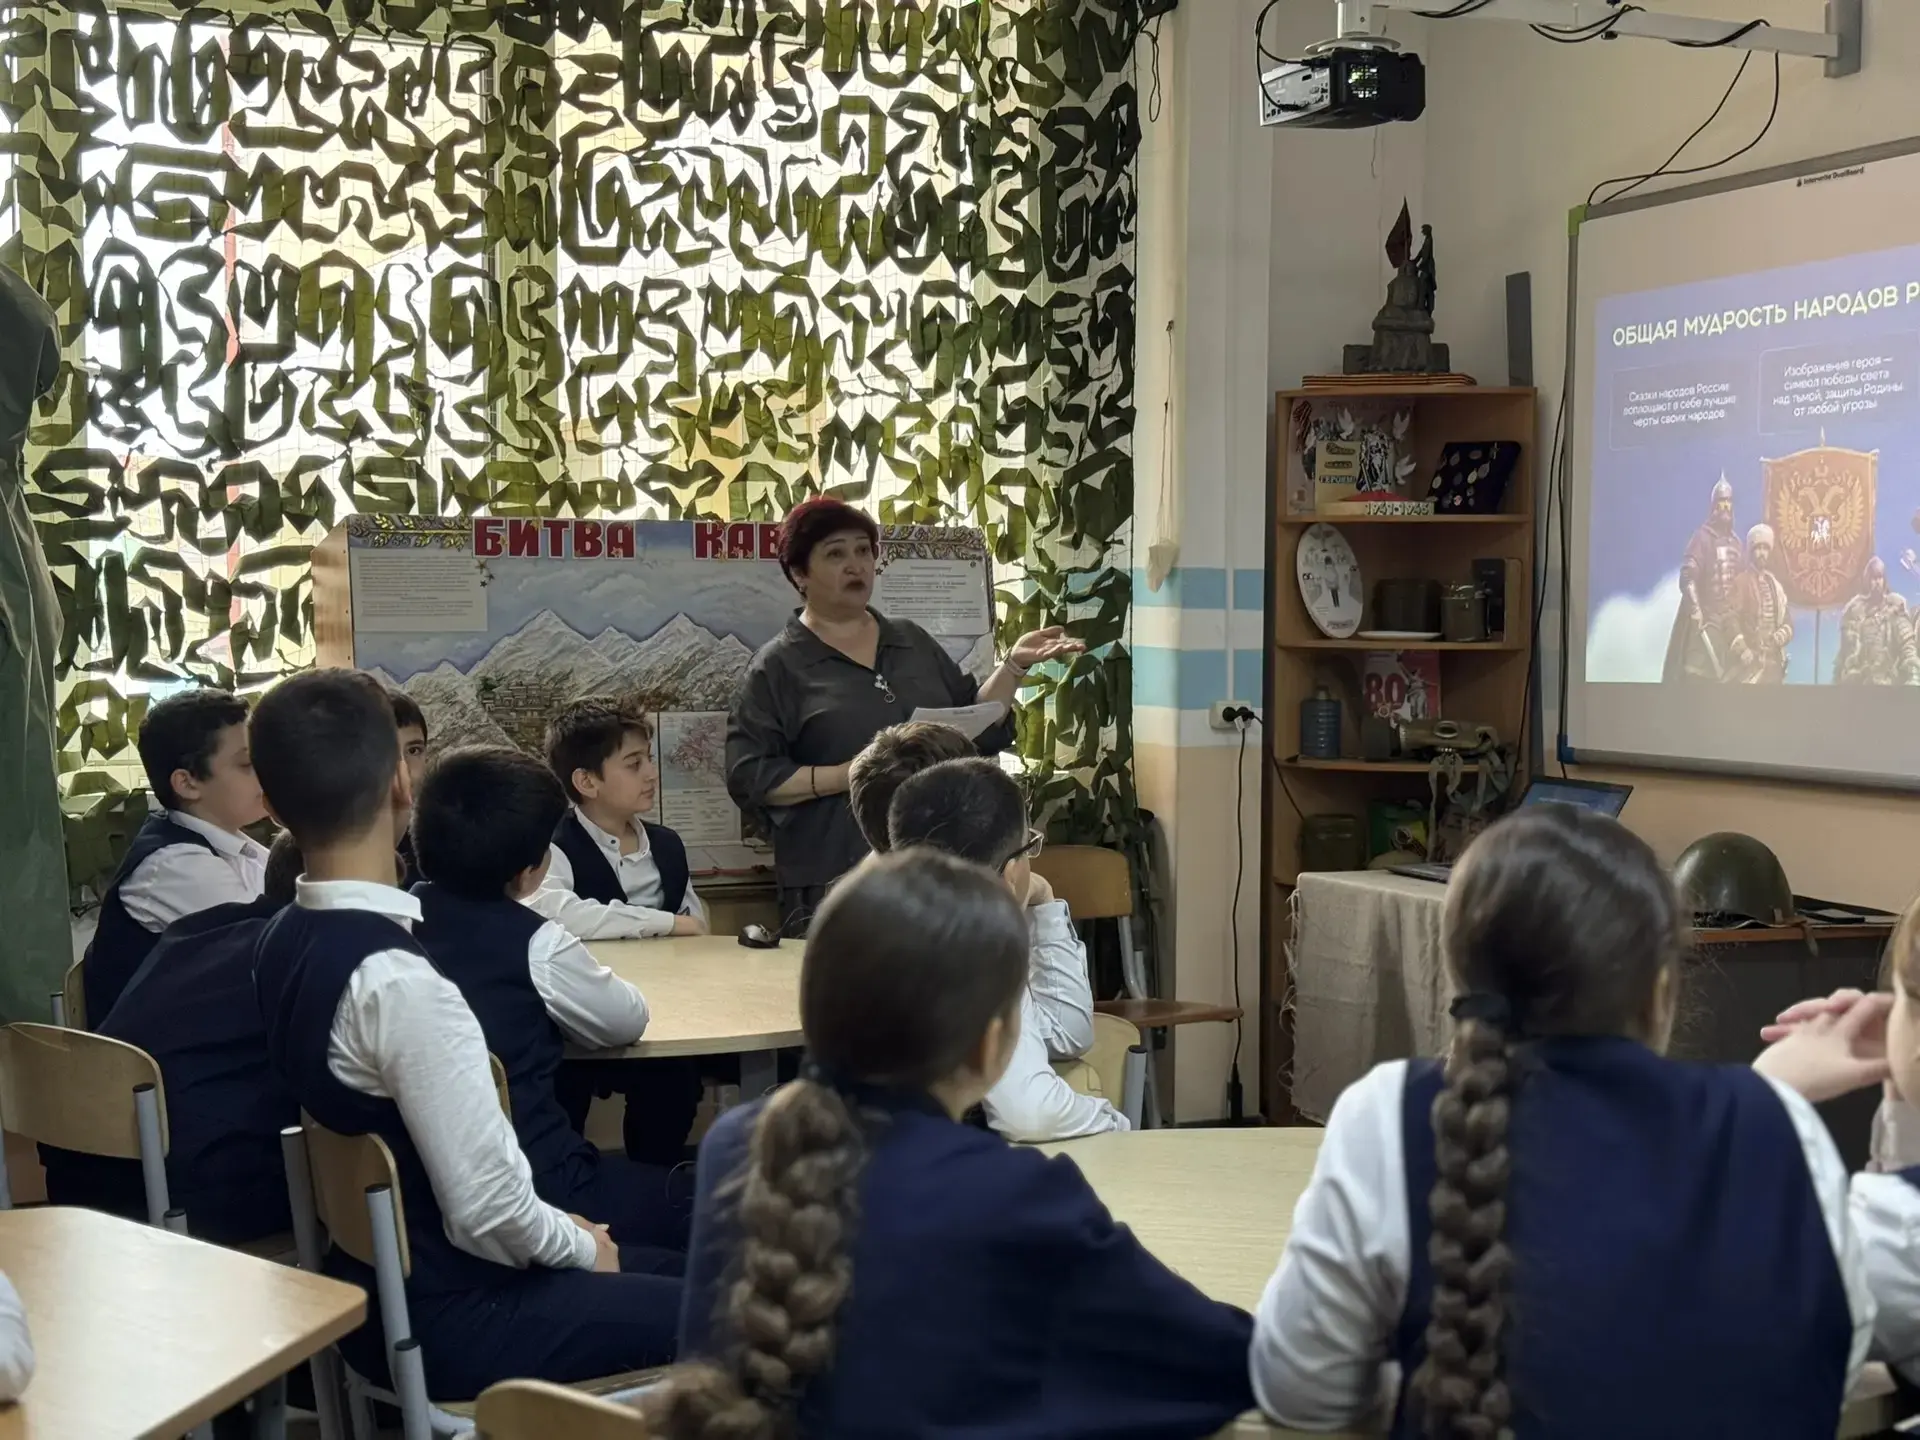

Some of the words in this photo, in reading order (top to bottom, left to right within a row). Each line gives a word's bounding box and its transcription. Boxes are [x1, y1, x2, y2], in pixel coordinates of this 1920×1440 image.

[1612, 319, 1677, 346] ОБЩАЯ
[1684, 304, 1787, 337] МУДРОСТЬ
[1794, 285, 1899, 321] НАРОДОВ
[1784, 362, 1850, 377] Изображение
[1851, 356, 1882, 370] героя
[1784, 377, 1820, 391] символ
[1820, 371, 1859, 386] победы
[1860, 370, 1890, 382] света
[1628, 391, 1658, 402] Сказки
[1658, 386, 1696, 400] народов
[1696, 383, 1730, 395] России
[1773, 394, 1790, 405] над
[1825, 386, 1862, 400] защиты
[1863, 381, 1904, 395] Родины
[1622, 402, 1672, 416] воплощают
[1672, 403, 1679, 411] в
[1679, 396, 1702, 409] себе
[1793, 406, 1805, 416] от
[1807, 400, 1840, 415] любой
[1841, 398, 1878, 413] угрозы
[1632, 417, 1660, 428] черты
[1660, 414, 1687, 424] своих
[1687, 409, 1726, 423] народов
[474, 517, 635, 558] БИТВА
[1364, 672, 1405, 714] 80
